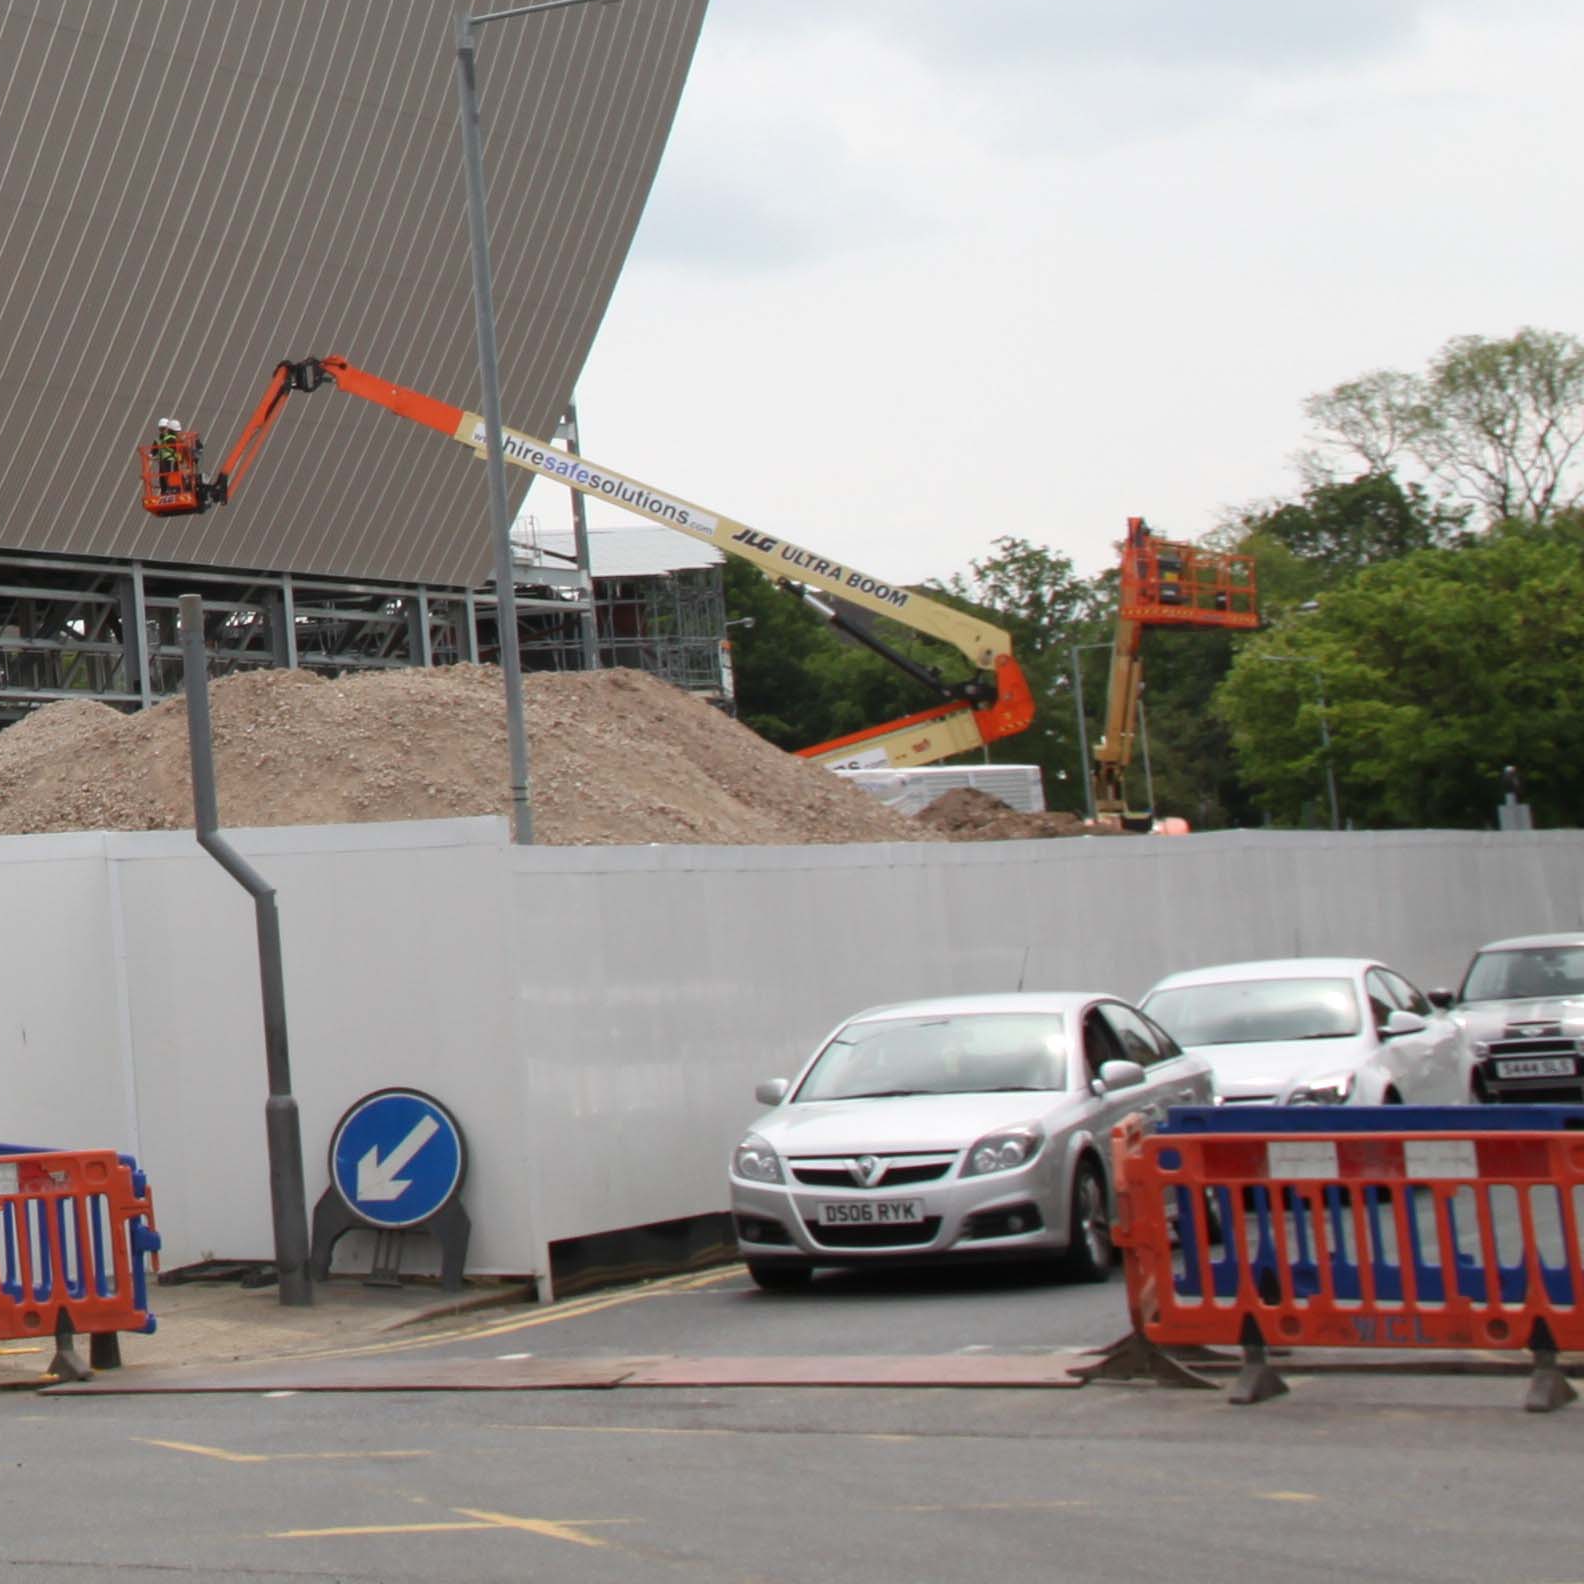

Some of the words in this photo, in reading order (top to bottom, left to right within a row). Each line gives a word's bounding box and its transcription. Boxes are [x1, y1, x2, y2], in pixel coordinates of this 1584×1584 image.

[732, 528, 778, 553] JLG
[781, 545, 841, 581] ULTRA
[845, 572, 909, 607] BOOM
